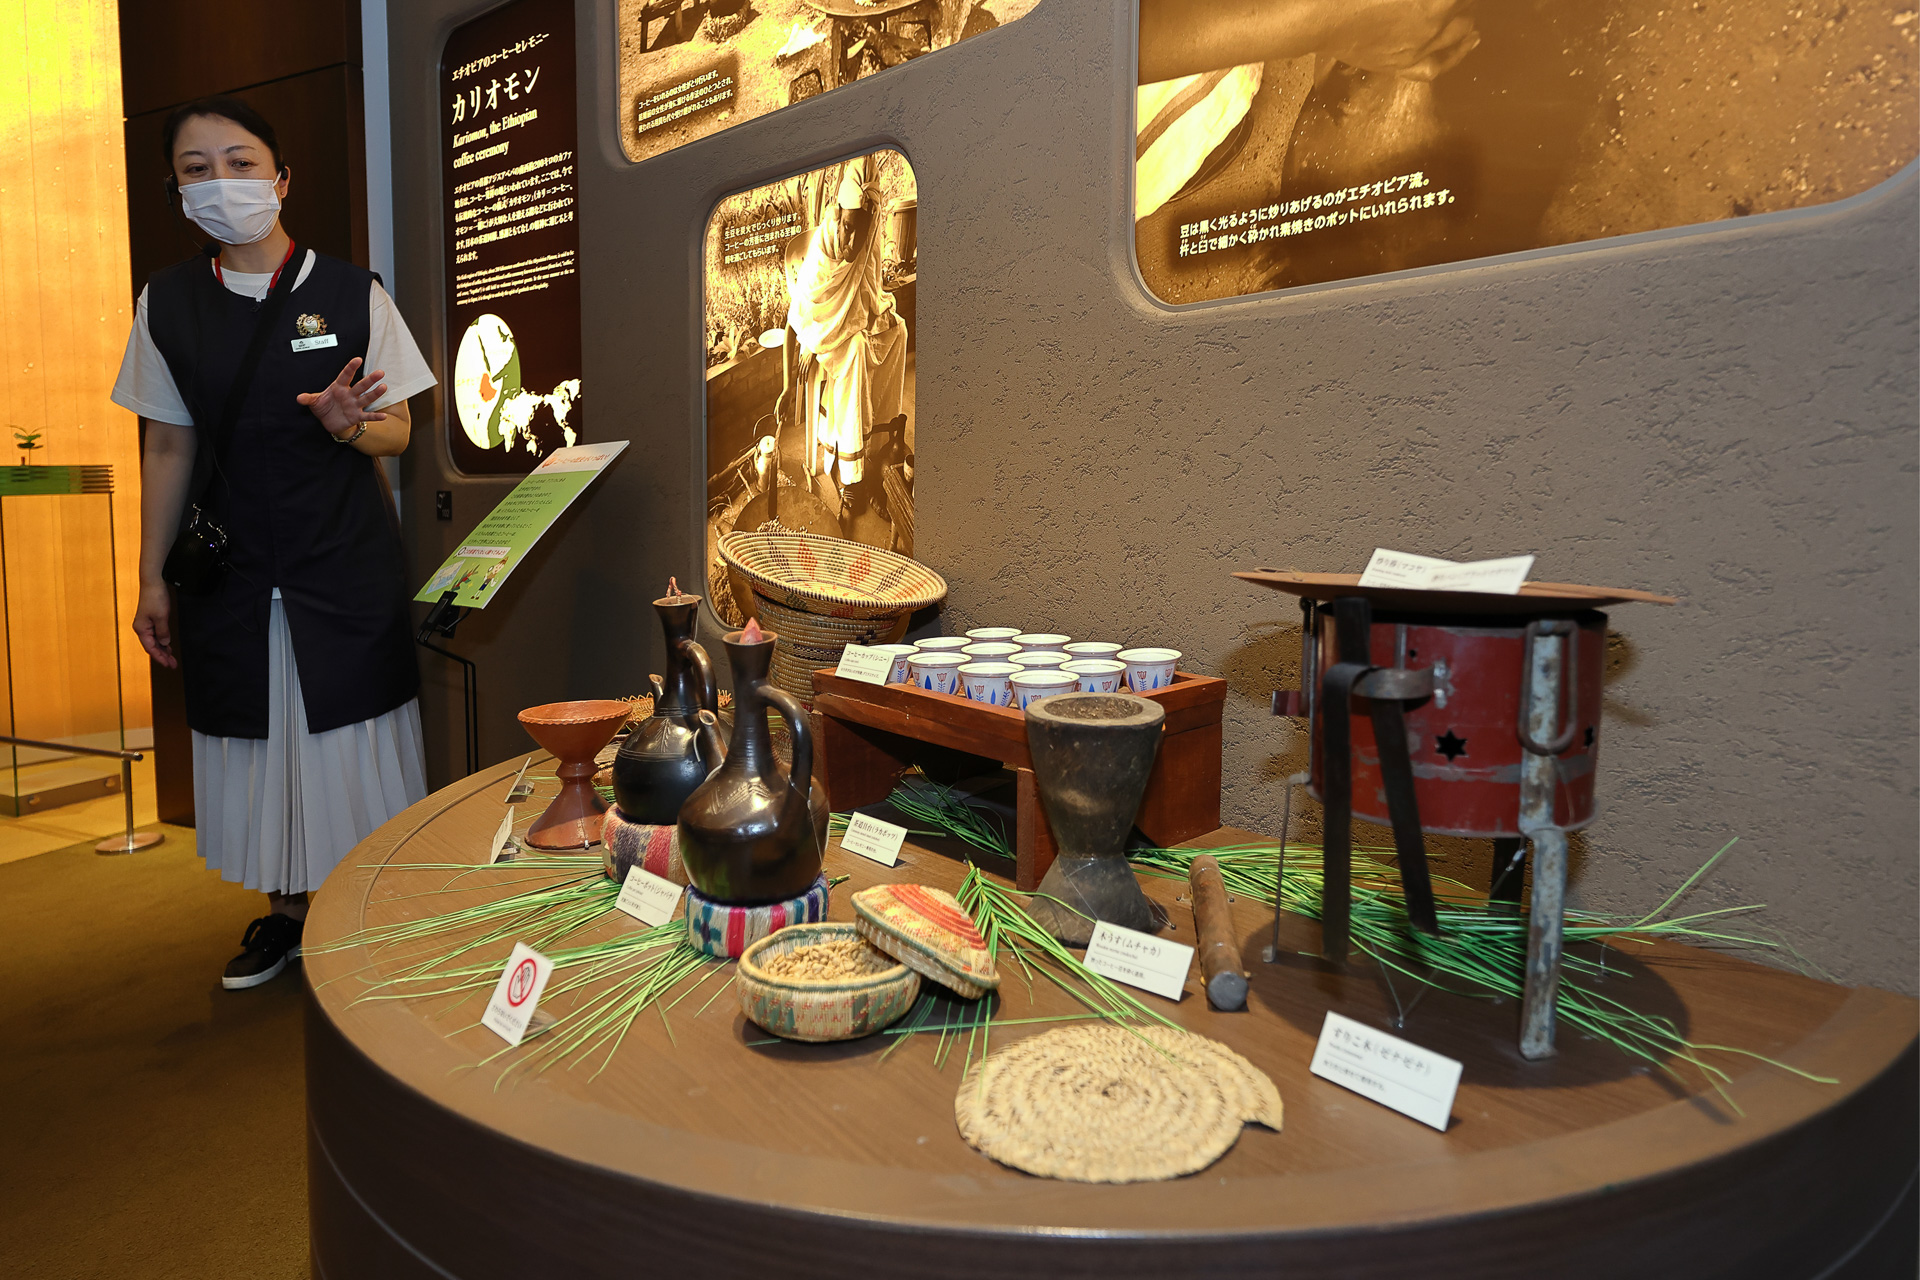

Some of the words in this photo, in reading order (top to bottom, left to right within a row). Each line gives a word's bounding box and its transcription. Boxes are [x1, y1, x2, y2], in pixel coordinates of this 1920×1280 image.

[452, 33, 550, 81] エチオピアのコーヒーセレモニー
[452, 66, 540, 125] カリオモン
[452, 127, 489, 148] Kariomon,
[489, 120, 502, 135] the
[502, 107, 538, 131] Ethiopian
[453, 151, 475, 169] coffee
[475, 141, 510, 160] ceremony
[1179, 188, 1456, 257] 杵と臼で細かく砕かれ素焼きのポットにいれられます。
[1180, 171, 1430, 239] 豆は黒く光るように炒りあげるのがエチオピア流。
[314, 338, 329, 346] Staff
